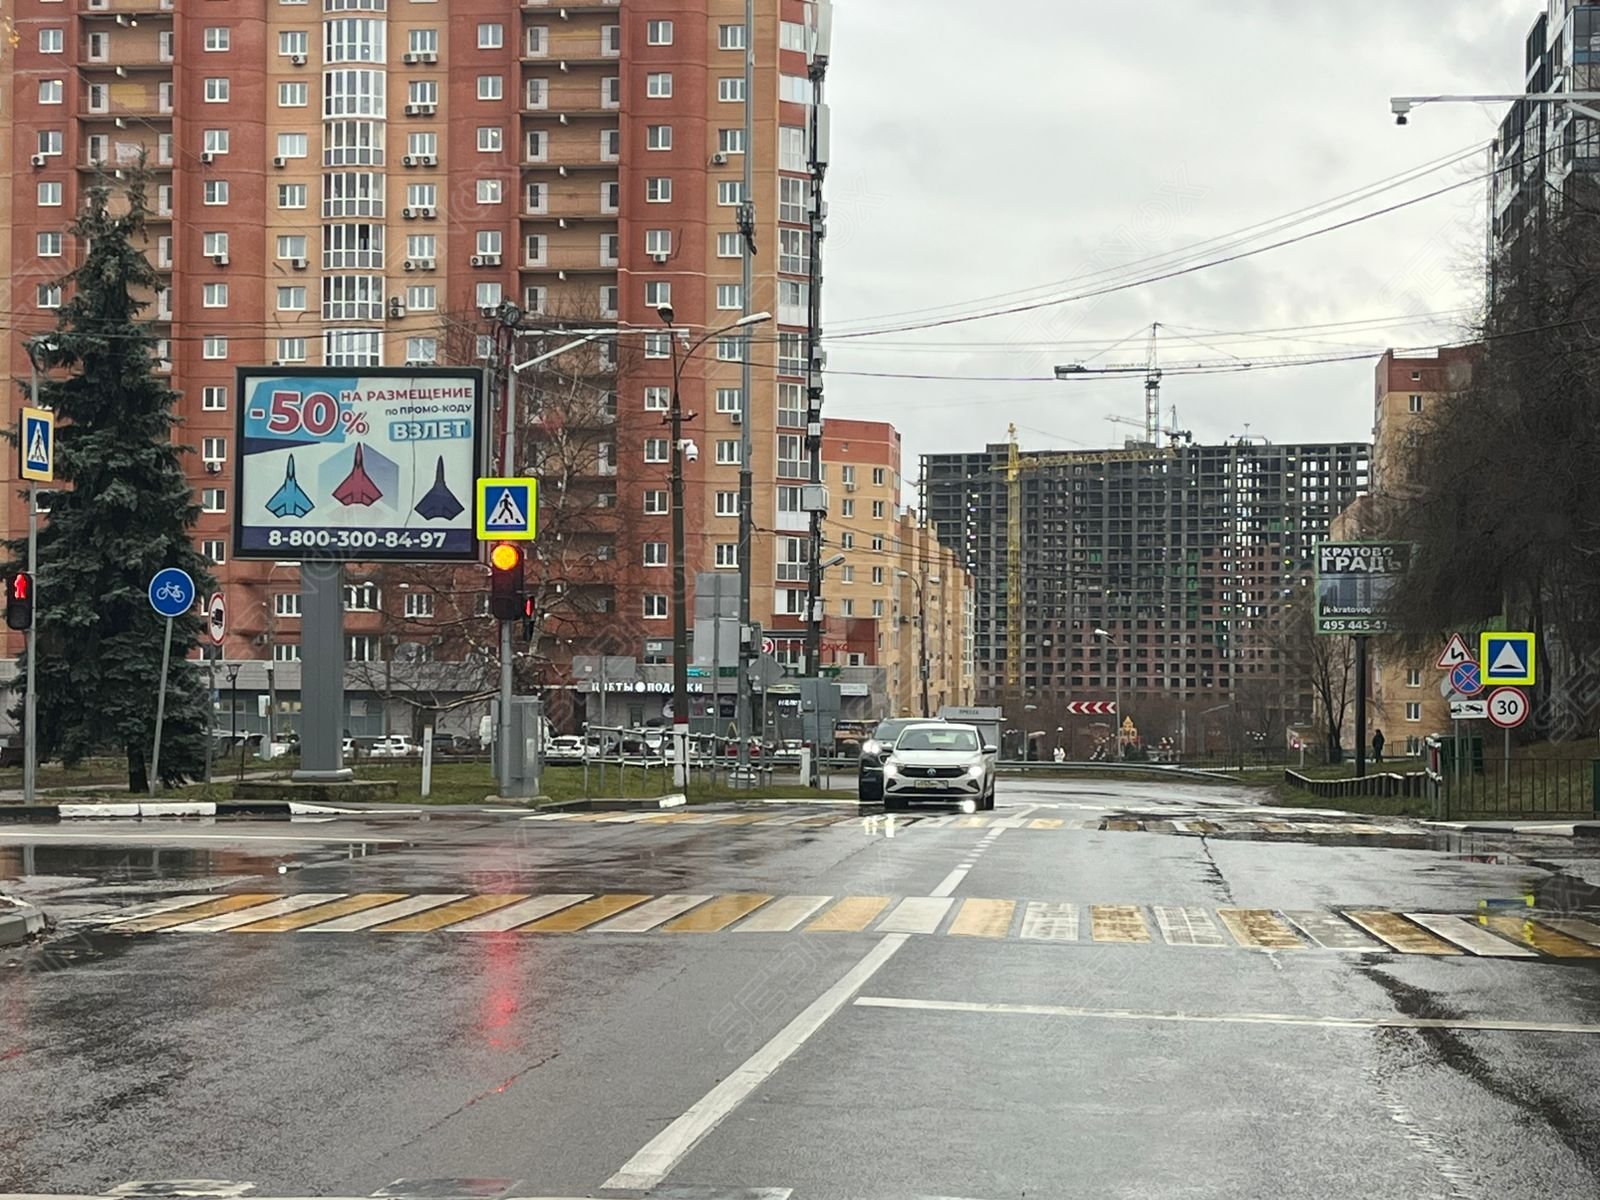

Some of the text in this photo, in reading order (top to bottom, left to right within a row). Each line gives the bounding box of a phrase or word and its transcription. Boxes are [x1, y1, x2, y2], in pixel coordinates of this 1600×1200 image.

[341, 387, 473, 402] НА РАЗМЕЩЕНИЕ
[400, 404, 472, 415] ПРОМО-КОДУ
[393, 421, 468, 440] ВЗЛЕТ
[268, 530, 446, 549] 8-800-300-84-97
[1321, 547, 1394, 557] КРАТОВО
[1323, 620, 1345, 630] 495
[647, 682, 703, 694] ПОДКИ
[1497, 700, 1518, 715] 30
